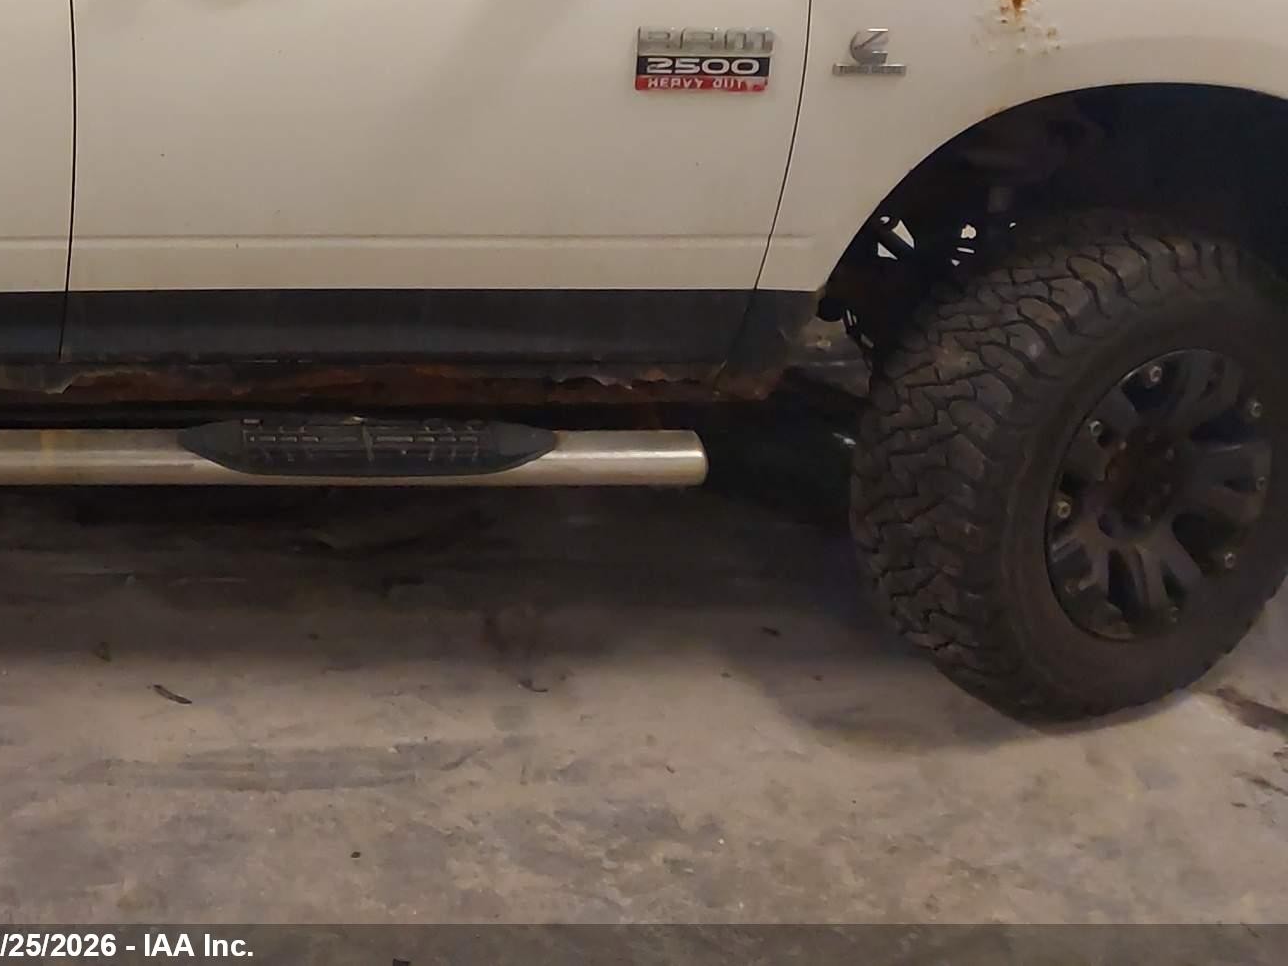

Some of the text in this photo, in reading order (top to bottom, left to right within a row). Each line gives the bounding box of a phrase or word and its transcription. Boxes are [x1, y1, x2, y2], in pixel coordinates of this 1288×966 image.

[638, 26, 774, 51] RAM
[646, 57, 760, 75] 2500
[647, 77, 704, 89] HEAVY
